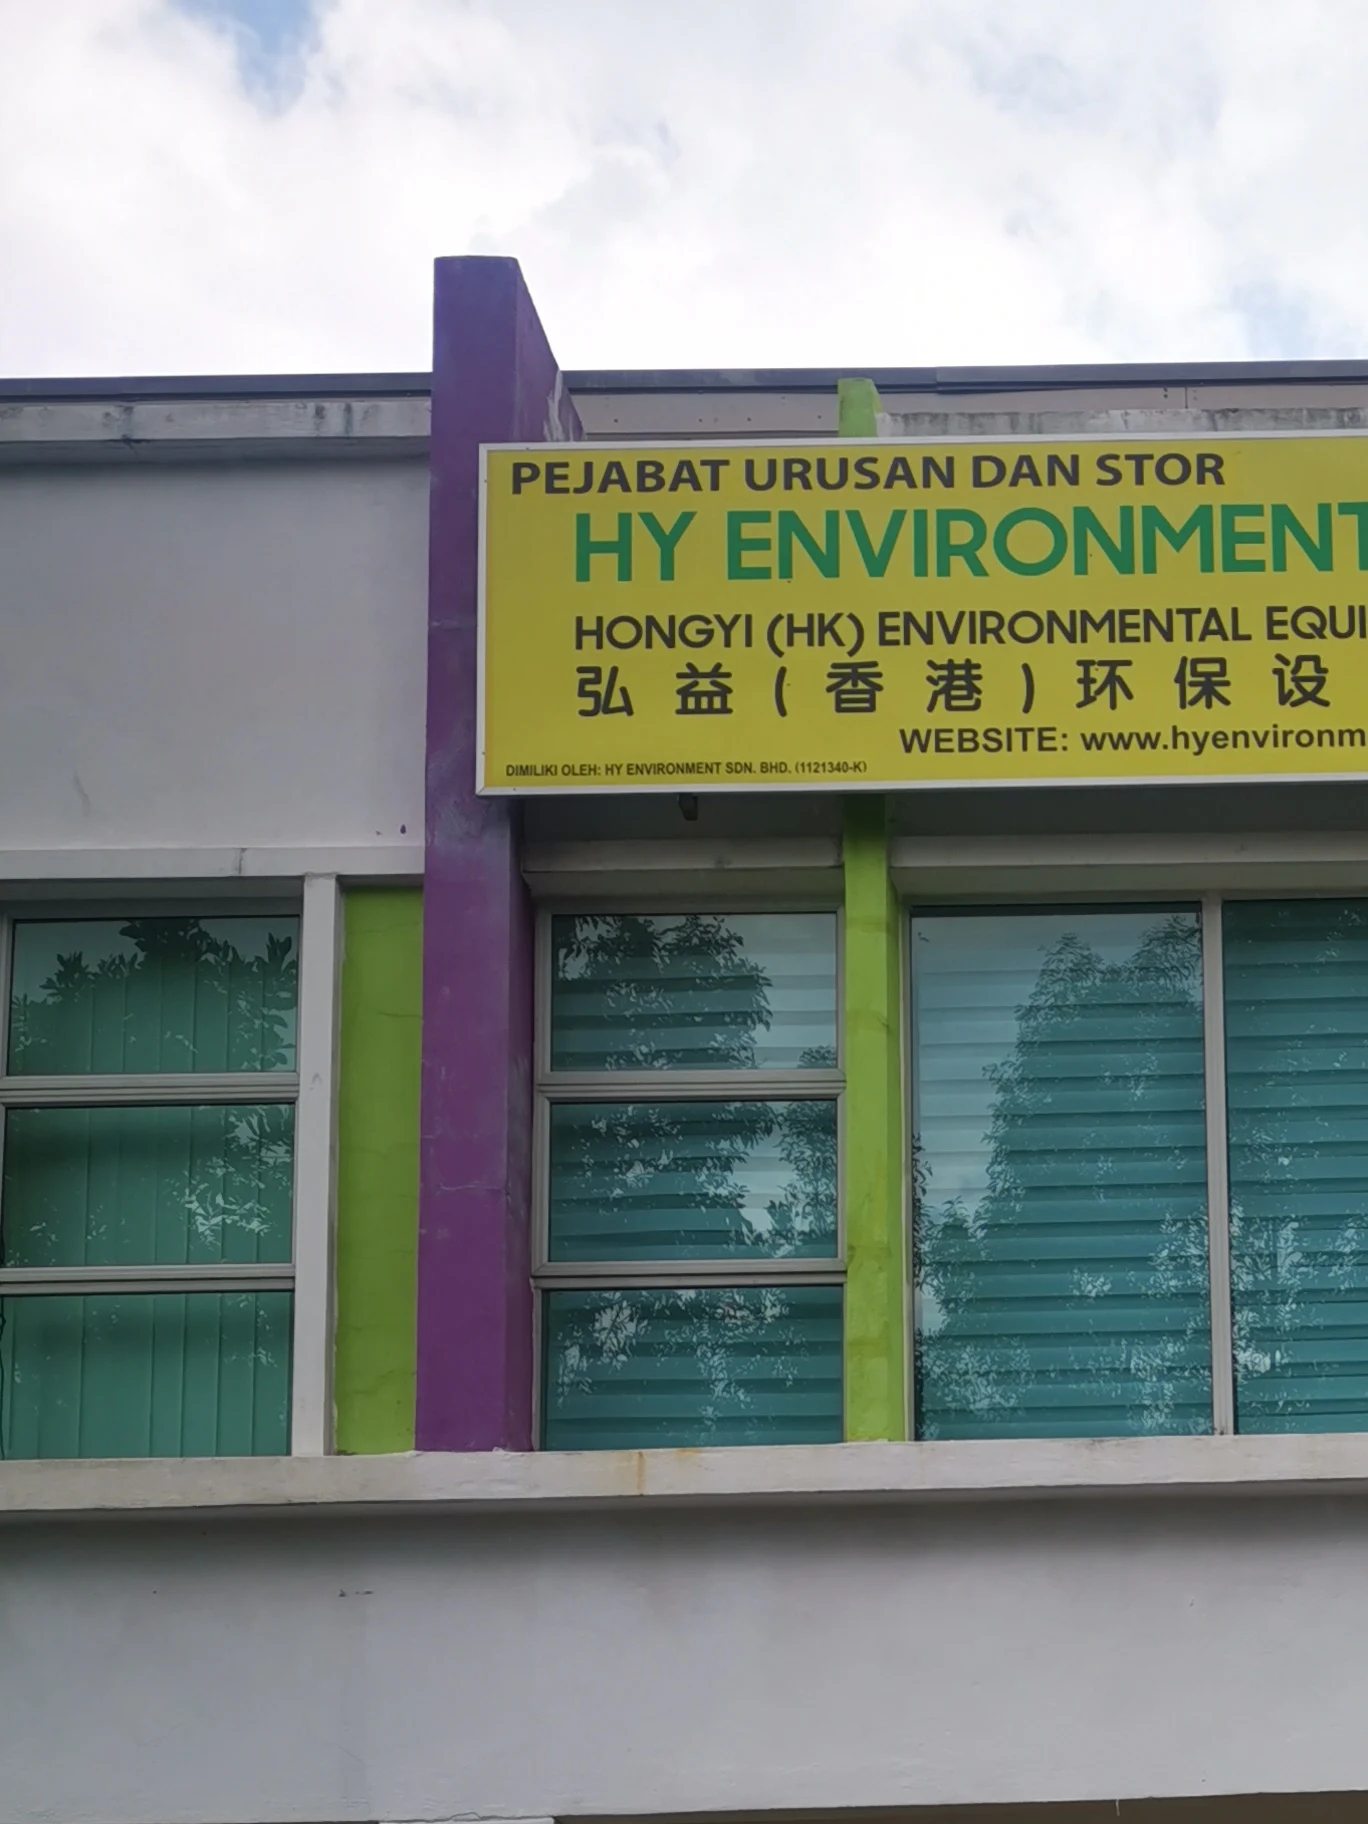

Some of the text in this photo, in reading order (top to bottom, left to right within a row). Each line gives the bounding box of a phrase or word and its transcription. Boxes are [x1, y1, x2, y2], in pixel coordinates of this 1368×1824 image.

[512, 452, 1226, 495] PEJABAT URUSAN DAN STOR
[576, 510, 698, 582] HY
[575, 613, 752, 650] HONGYI
[766, 612, 865, 658] (HK)
[878, 608, 1252, 646] ENVIRONMENTAL
[900, 727, 1069, 754] WEBSITE:
[505, 760, 867, 777] DIMILIKI OLEH: HY ENVIRONMENT SDN. BHD. (1121340-K)
